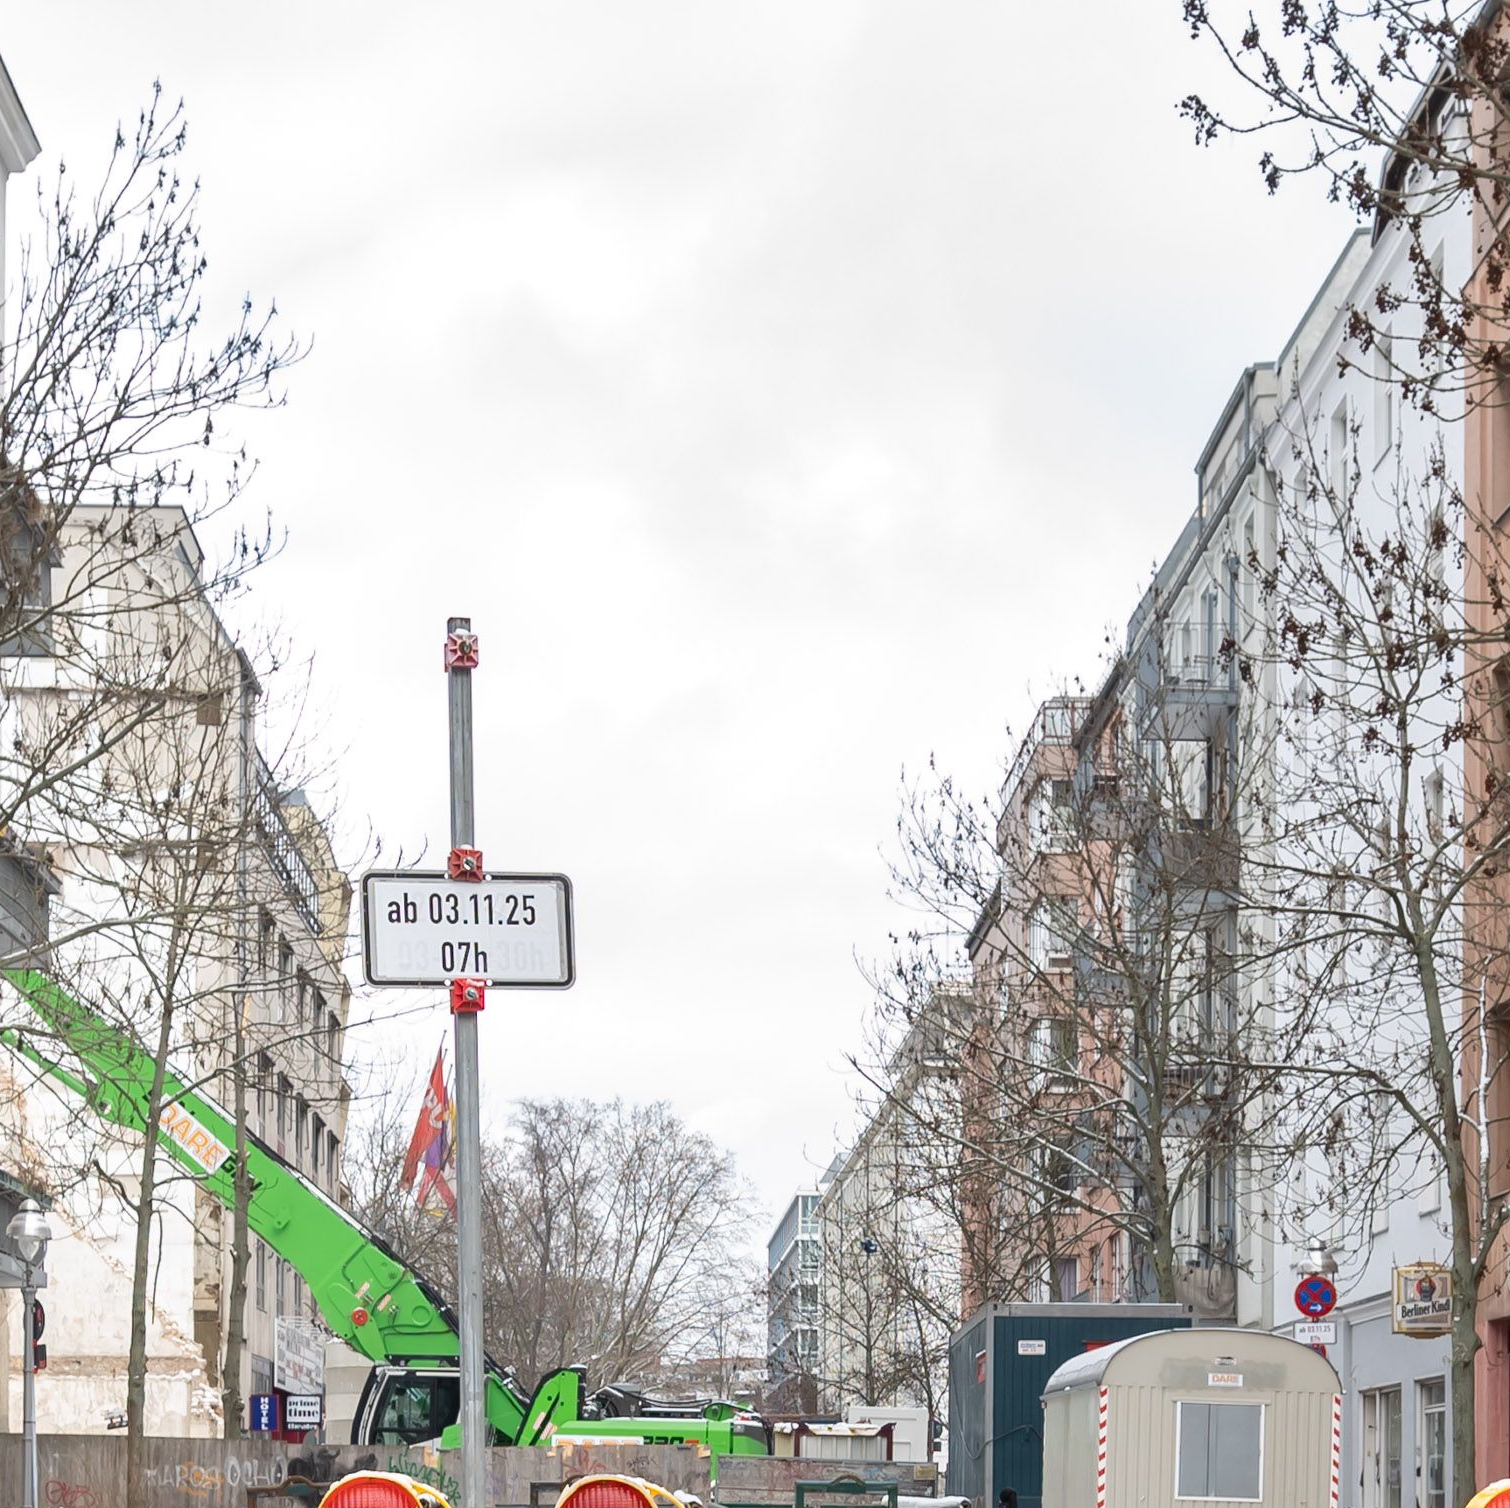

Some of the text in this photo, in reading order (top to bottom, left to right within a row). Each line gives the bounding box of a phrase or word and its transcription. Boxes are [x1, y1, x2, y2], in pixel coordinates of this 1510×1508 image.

[387, 892, 536, 926] ab 03.11.25
[441, 941, 489, 973] 07h
[1401, 1299, 1452, 1319] Berliner Kindl
[1212, 1375, 1239, 1384] DARE
[259, 1396, 270, 1430] HOTEL
[288, 1400, 319, 1408] prime
[288, 1408, 319, 1418] time
